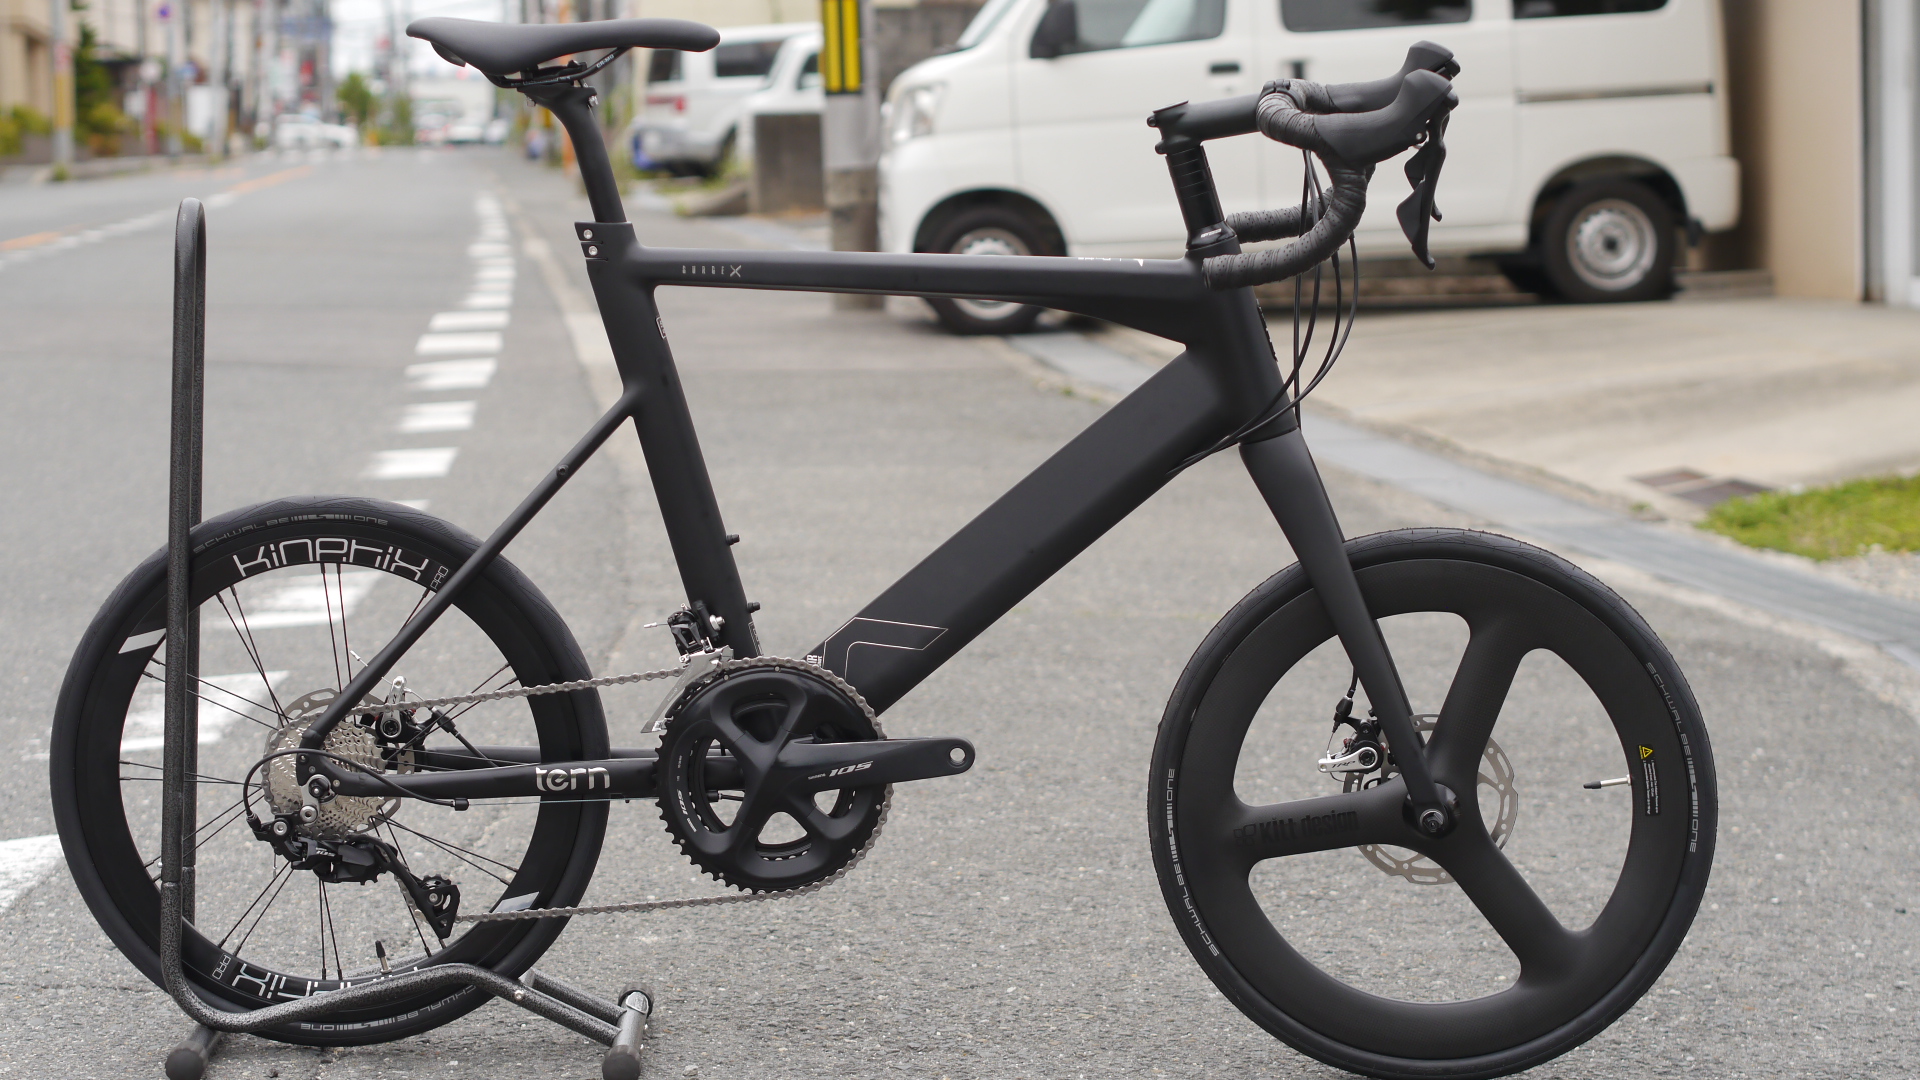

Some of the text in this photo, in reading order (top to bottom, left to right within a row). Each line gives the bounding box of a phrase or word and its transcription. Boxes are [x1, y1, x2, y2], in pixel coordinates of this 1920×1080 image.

[193, 515, 389, 554] SCHWALBE ONE
[430, 566, 449, 590] PRO
[535, 766, 611, 792] tern
[1645, 662, 1692, 756] SCHWALBE
[1689, 818, 1699, 853] ONE
[1166, 768, 1220, 957] SCHWALBE ONE
[300, 984, 478, 1032] CHWALBE ONE
